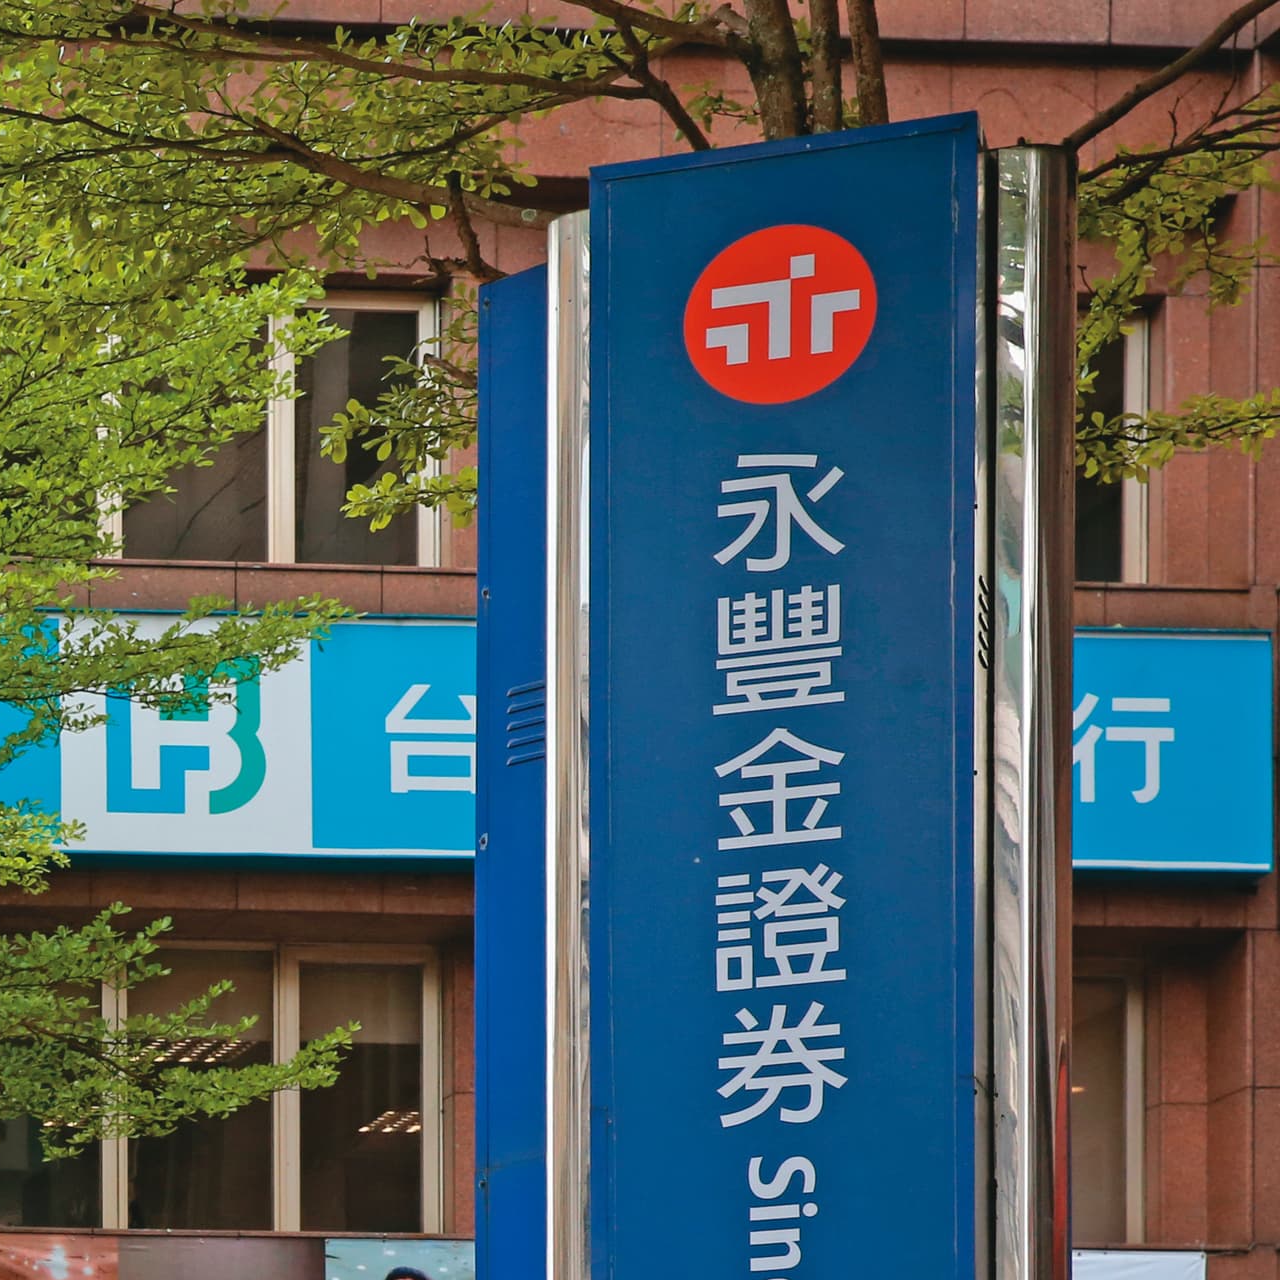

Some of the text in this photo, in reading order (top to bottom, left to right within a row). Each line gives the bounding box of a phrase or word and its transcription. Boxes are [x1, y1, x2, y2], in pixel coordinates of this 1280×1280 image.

[713, 453, 848, 1128] 永豐金證券
